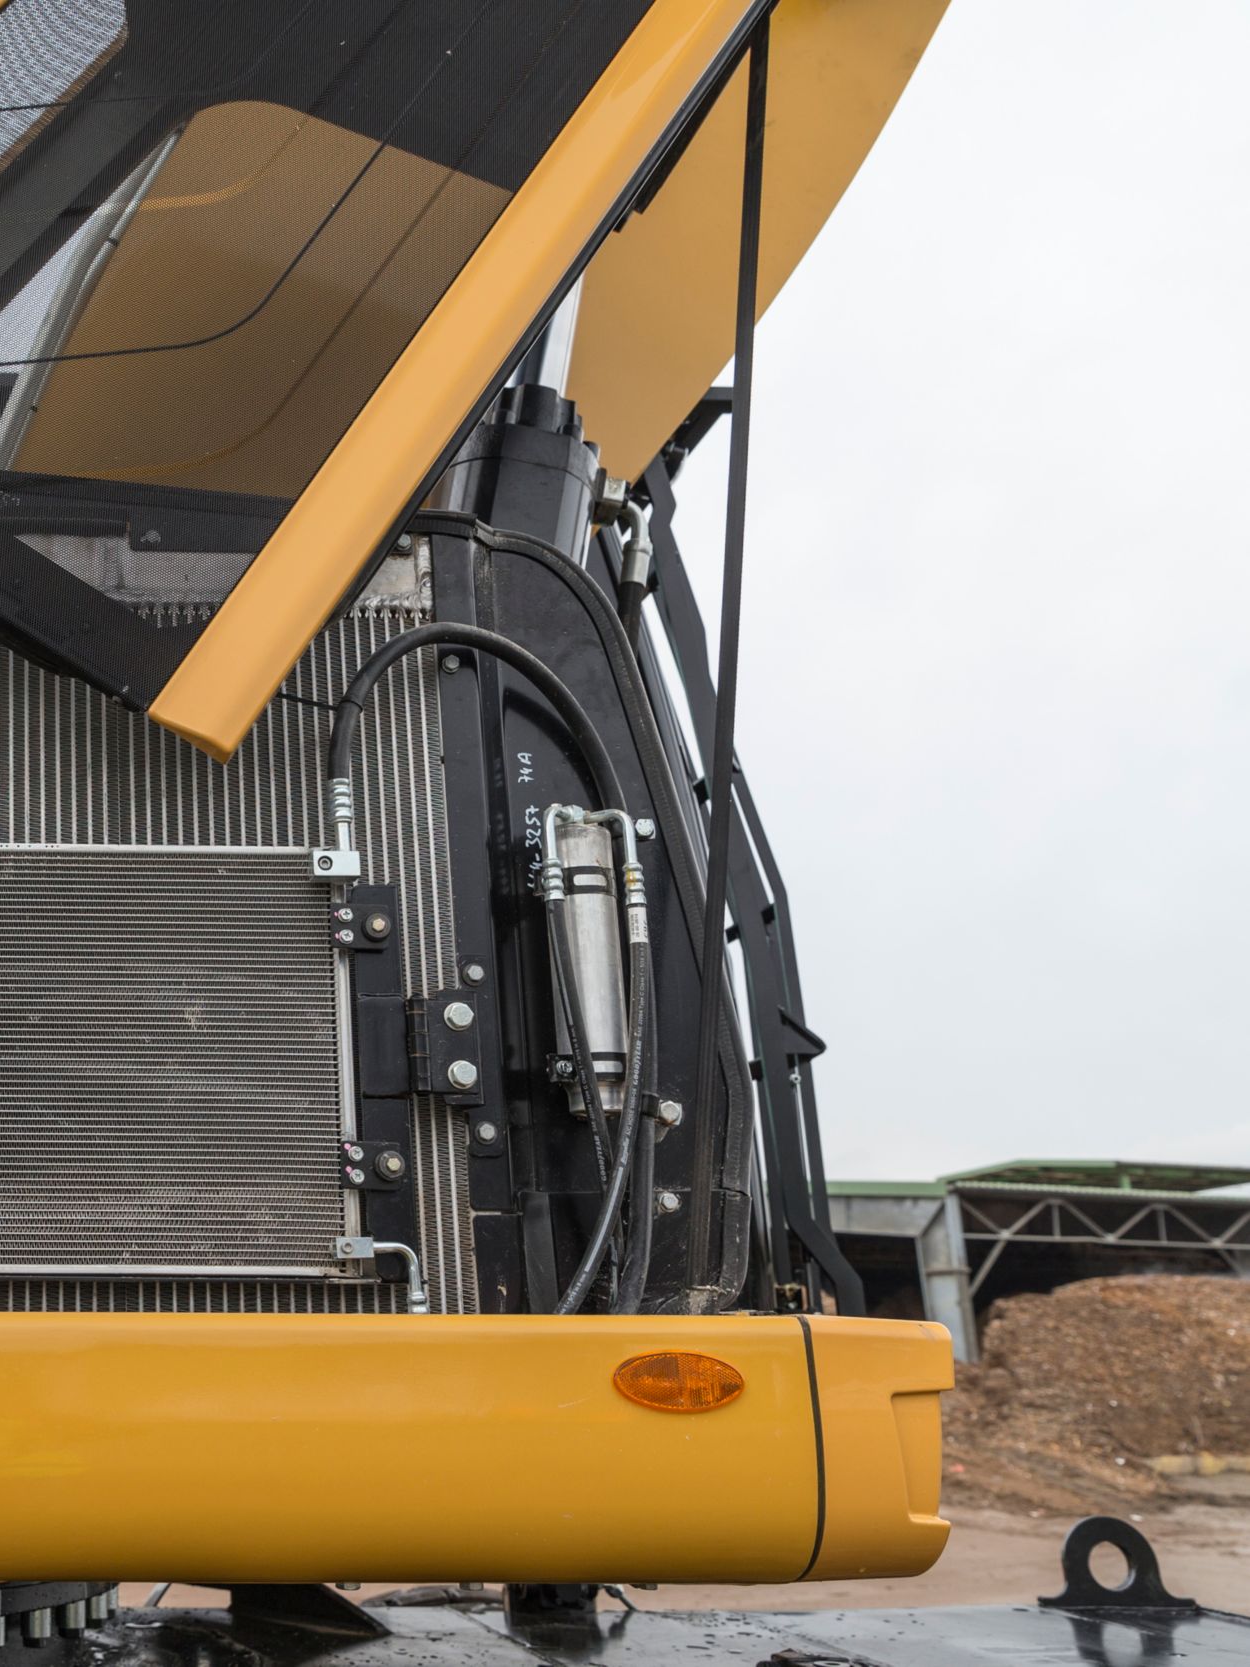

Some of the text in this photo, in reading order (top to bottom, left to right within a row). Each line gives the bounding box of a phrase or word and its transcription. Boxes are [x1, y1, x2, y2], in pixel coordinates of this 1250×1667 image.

[517, 751, 543, 889] 4-3257 74A
[632, 1040, 643, 1086] GOODYEAR
[594, 1135, 607, 1181] GOODYEAR
